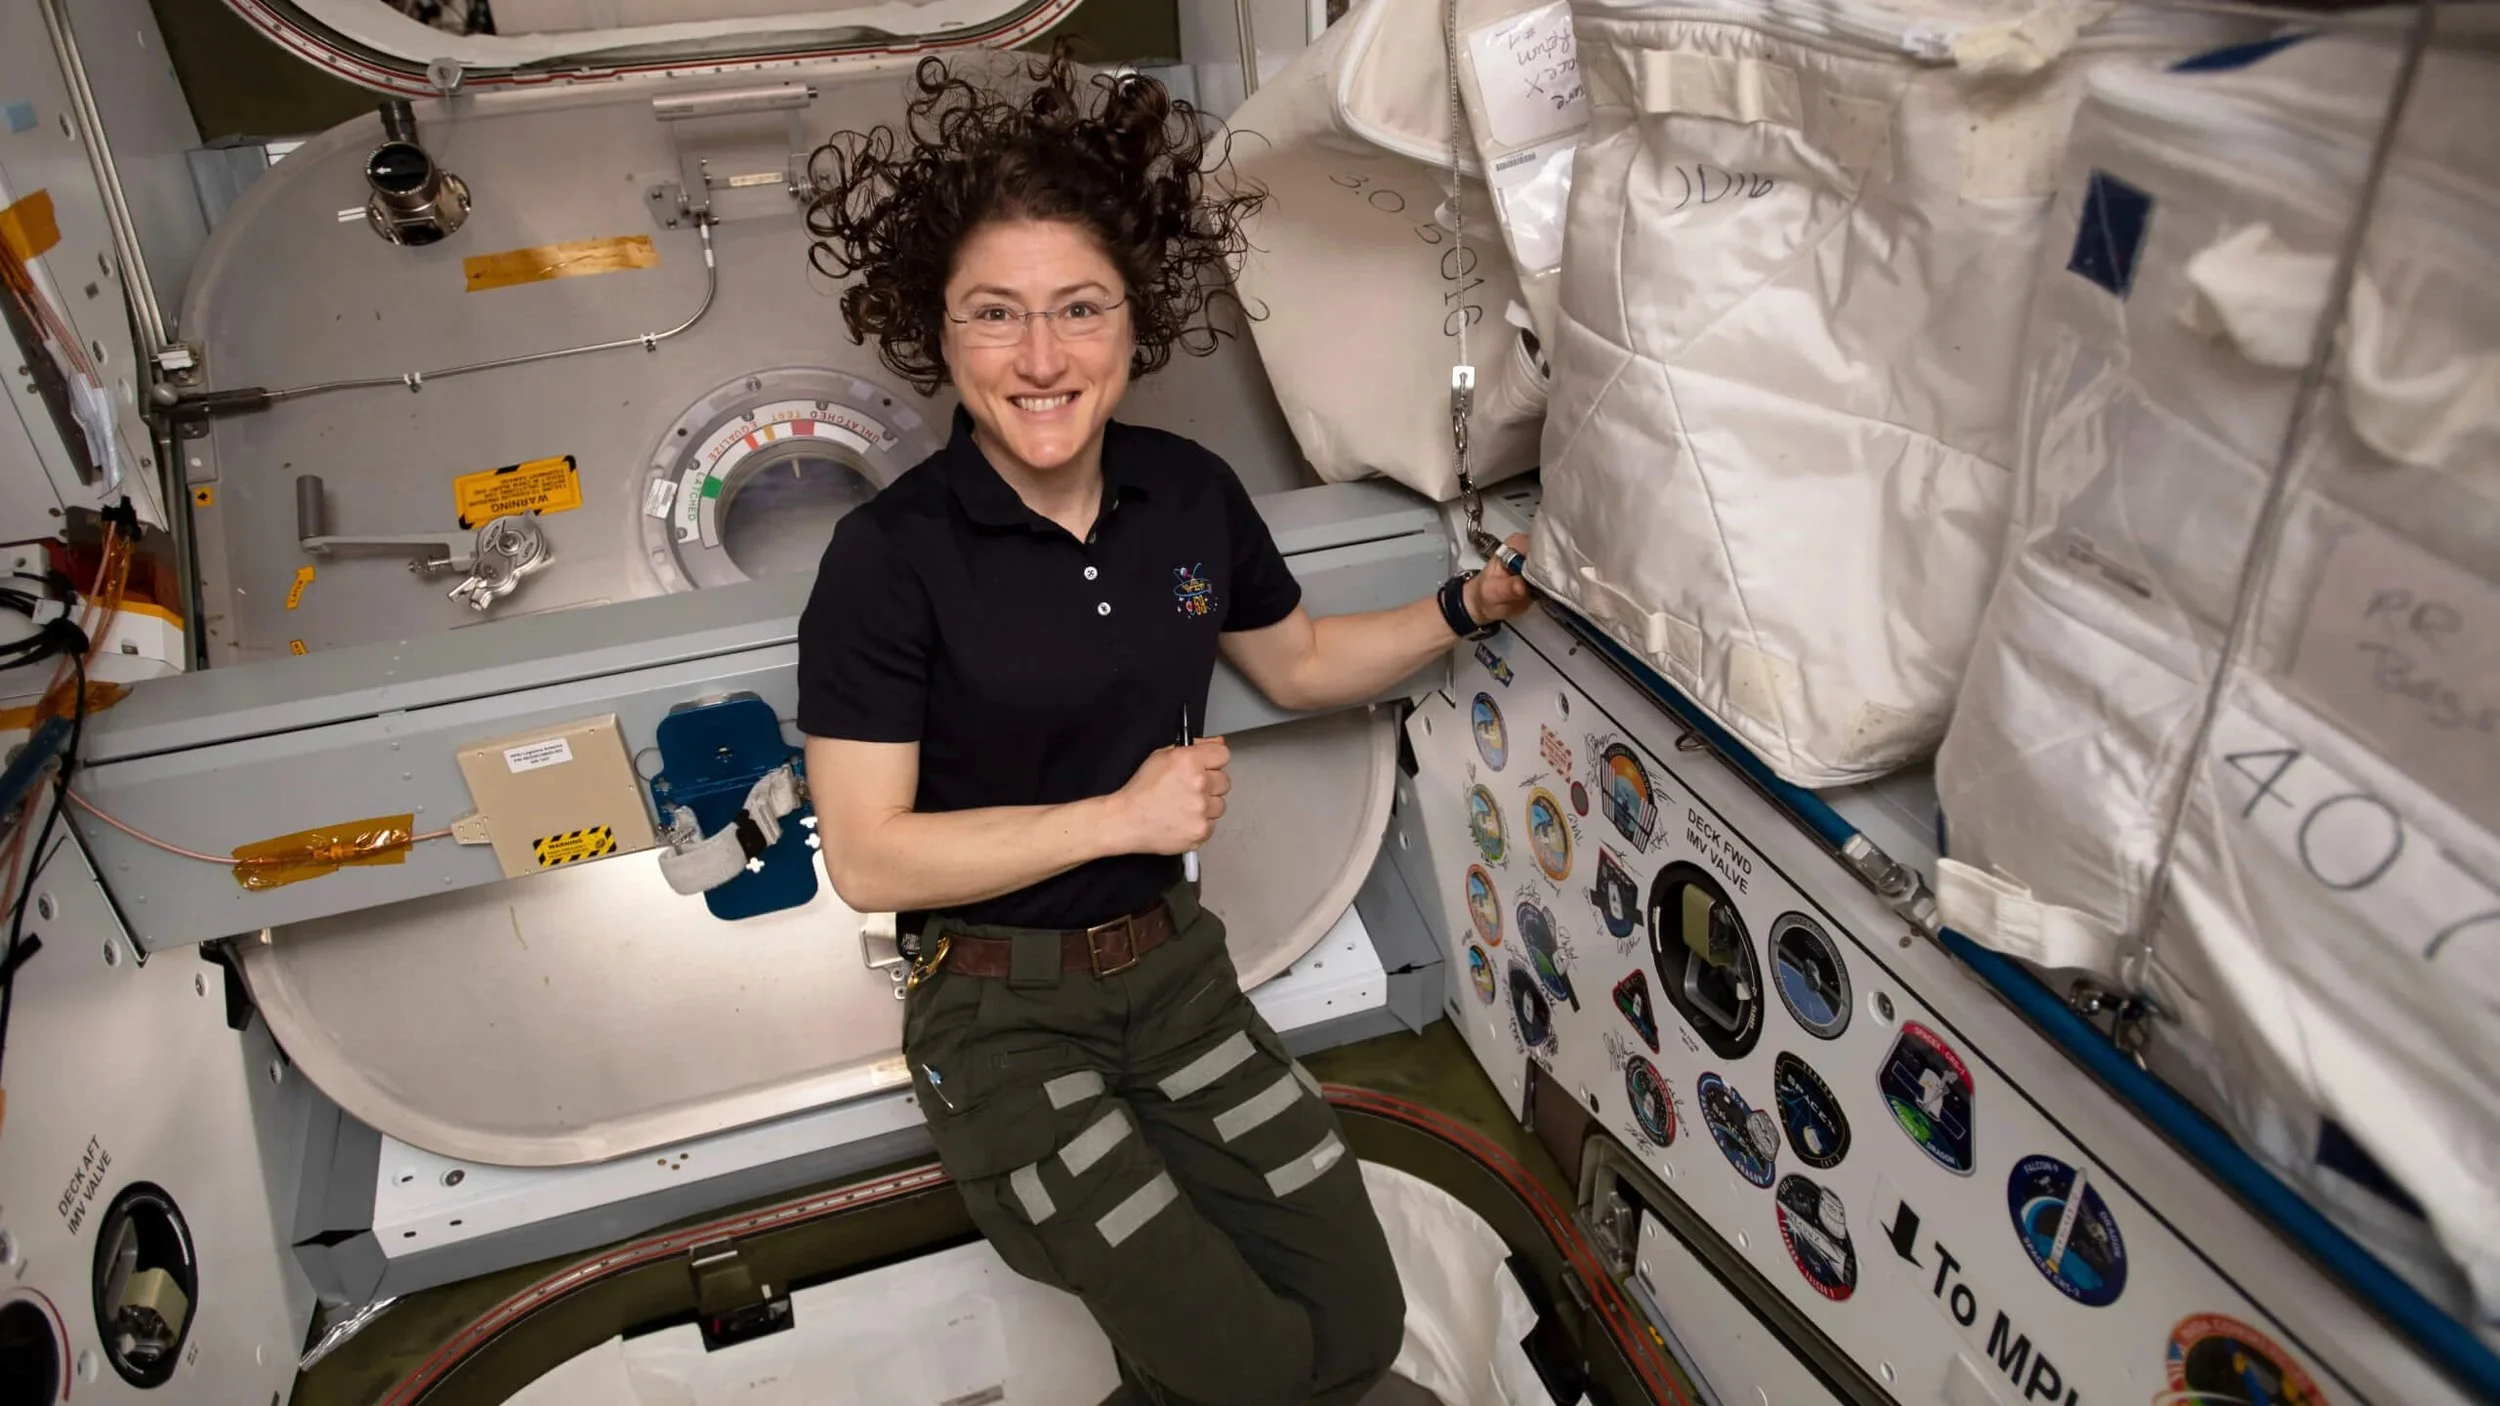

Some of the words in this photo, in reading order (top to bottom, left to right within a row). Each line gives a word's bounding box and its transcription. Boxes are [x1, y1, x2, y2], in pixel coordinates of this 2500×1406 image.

[1516, 28, 1571, 66] Return
[707, 420, 758, 462] EQUALIZE
[771, 409, 801, 423] TEST
[809, 409, 880, 444] UNLATCHED
[489, 494, 550, 513] WARNING
[686, 471, 709, 522] LATCHED
[1685, 827, 1709, 858] IMV
[1710, 849, 1750, 896] VALVE
[1687, 808, 1722, 848] DECK
[1723, 841, 1753, 876] FWD
[1786, 1073, 1837, 1135] SPACEX
[57, 1167, 86, 1219] DECK
[83, 1134, 101, 1173] AFT
[67, 1197, 87, 1236] IMV
[84, 1149, 113, 1203] VALVE
[2099, 1210, 2122, 1259] DRAGON
[1986, 1309, 2080, 1406] MP
